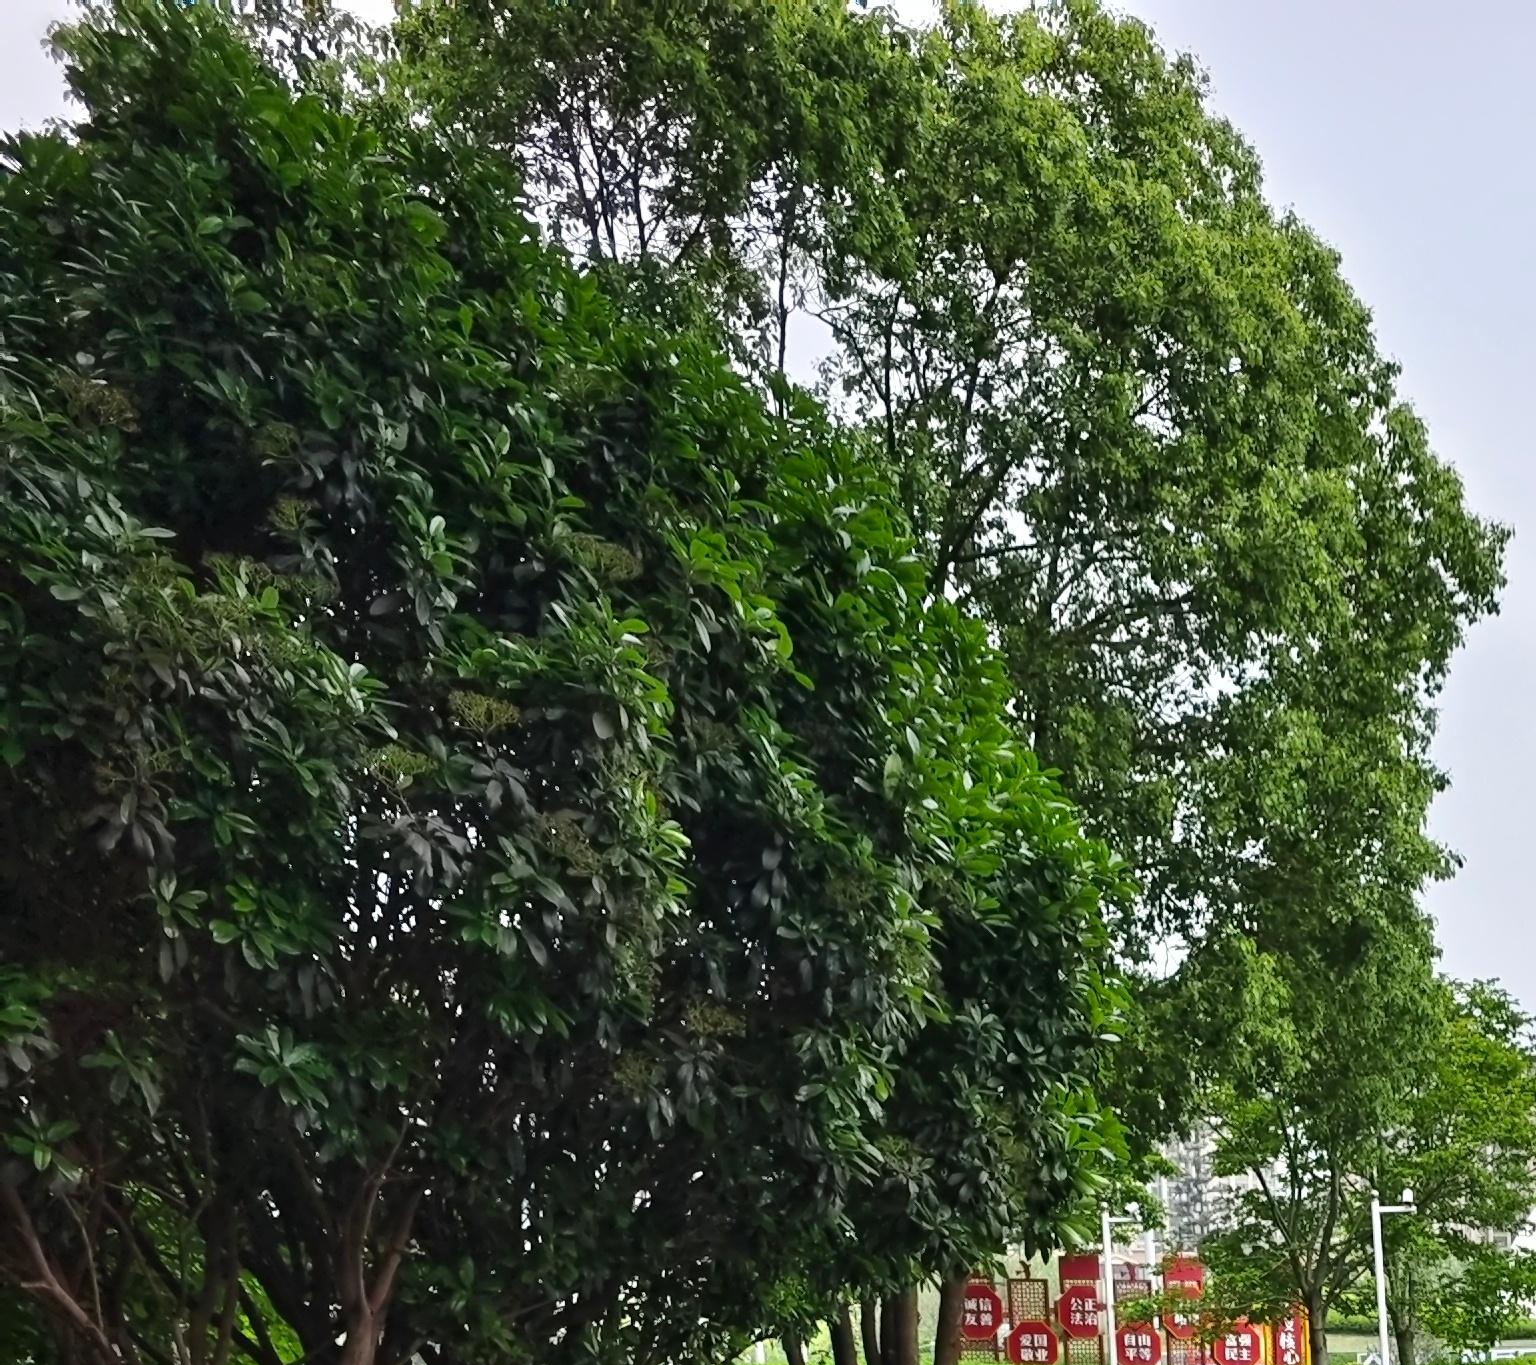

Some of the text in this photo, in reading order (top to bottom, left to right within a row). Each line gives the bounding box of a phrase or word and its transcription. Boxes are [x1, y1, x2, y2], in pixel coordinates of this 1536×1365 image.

[964, 1298, 992, 1312] 诚信
[1070, 1298, 1097, 1311] 公正
[964, 1313, 993, 1327] 友善
[1070, 1313, 1098, 1326] 法治
[1020, 1334, 1048, 1347] 爱国
[1124, 1333, 1152, 1347] 自由
[1225, 1334, 1252, 1347] 富强
[1020, 1349, 1049, 1362] 敬业
[1125, 1347, 1152, 1361] 平等
[1225, 1347, 1252, 1361] 民主
